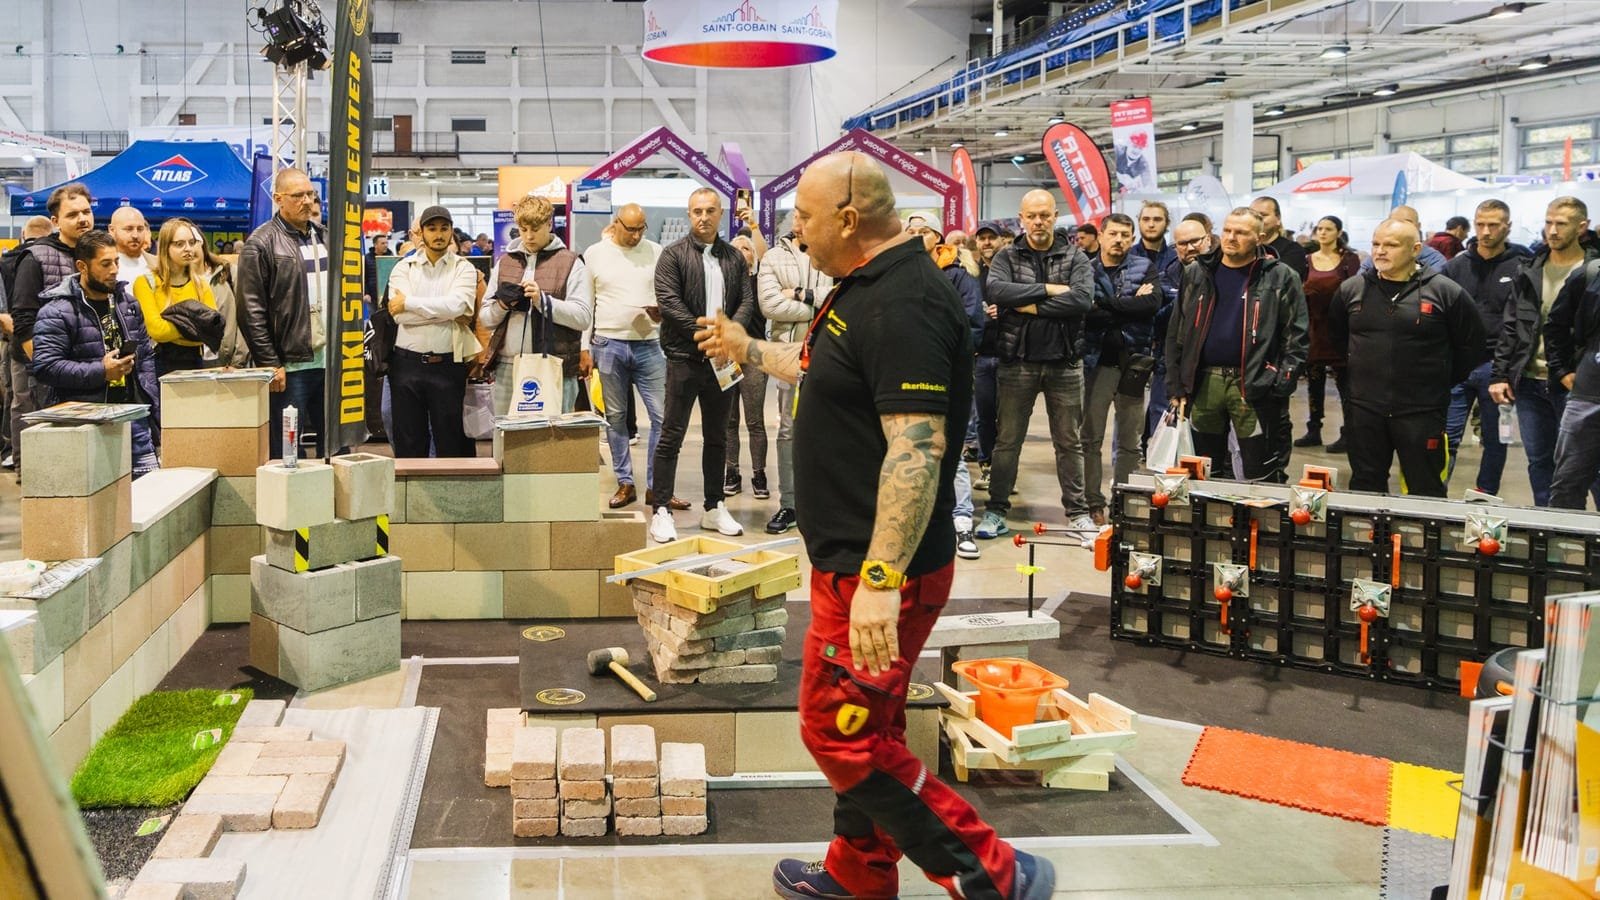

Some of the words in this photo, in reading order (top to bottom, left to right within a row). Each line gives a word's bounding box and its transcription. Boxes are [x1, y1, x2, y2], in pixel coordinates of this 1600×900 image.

[702, 23, 777, 33] SAINT-GOBAIN
[346, 51, 362, 194] CENTER
[151, 169, 192, 182] ATLAS
[342, 201, 364, 322] STONE
[340, 330, 365, 424] DOKI
